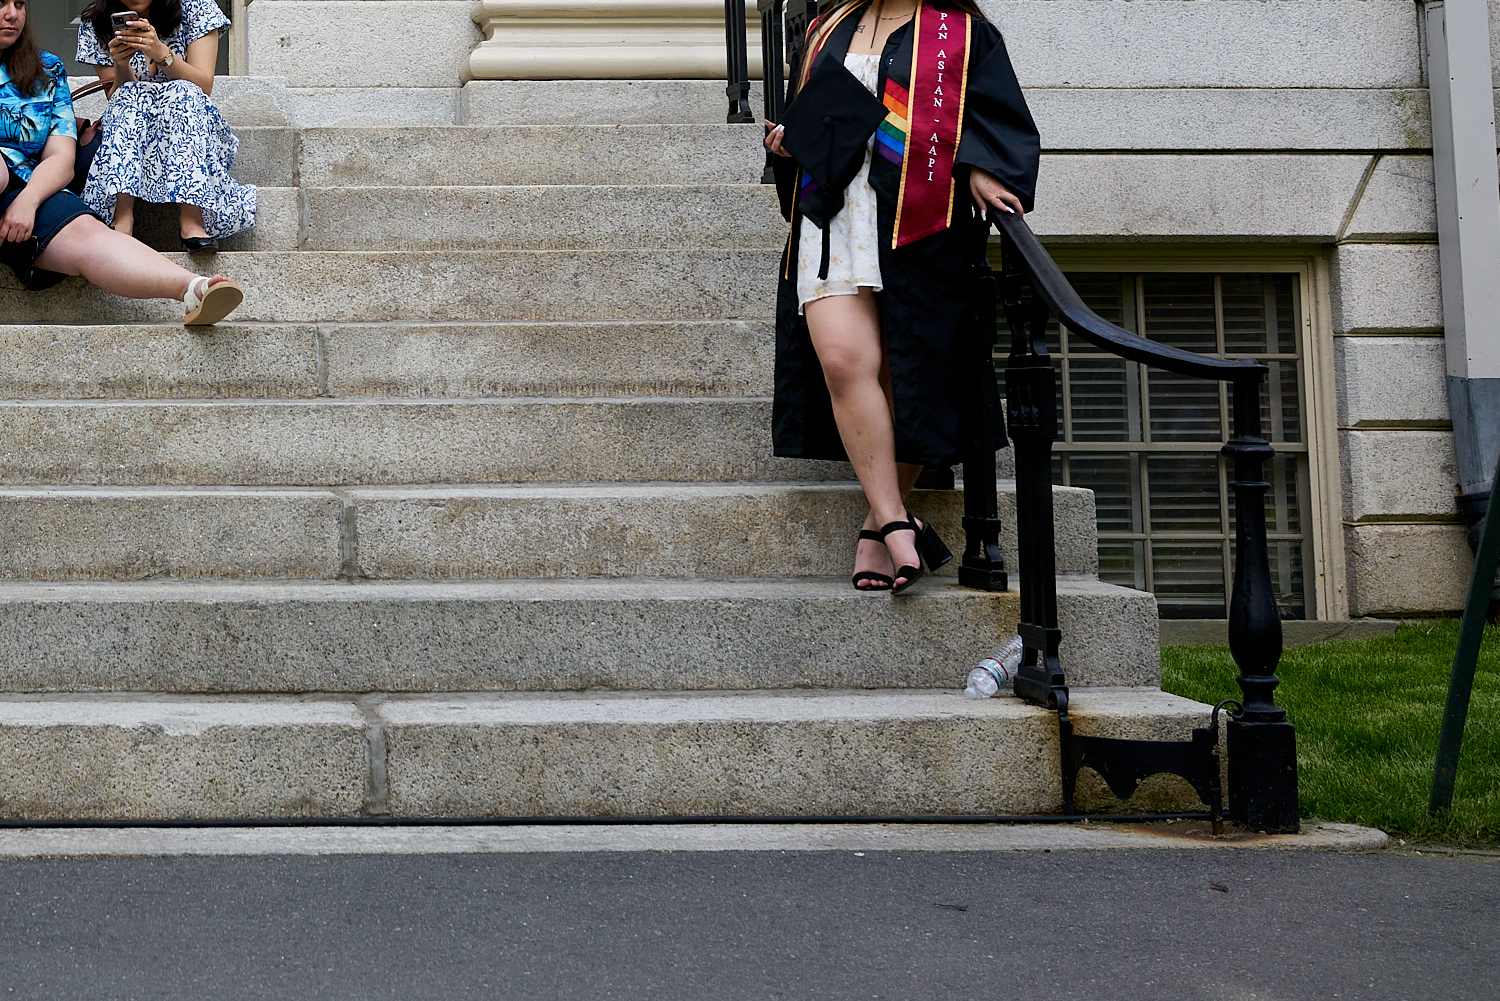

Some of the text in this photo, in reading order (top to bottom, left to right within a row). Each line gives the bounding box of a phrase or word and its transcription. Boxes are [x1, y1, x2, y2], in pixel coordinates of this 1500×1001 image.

[937, 12, 948, 40] PAN
[933, 49, 947, 108] ASIAN
[927, 132, 939, 182] AAPI
